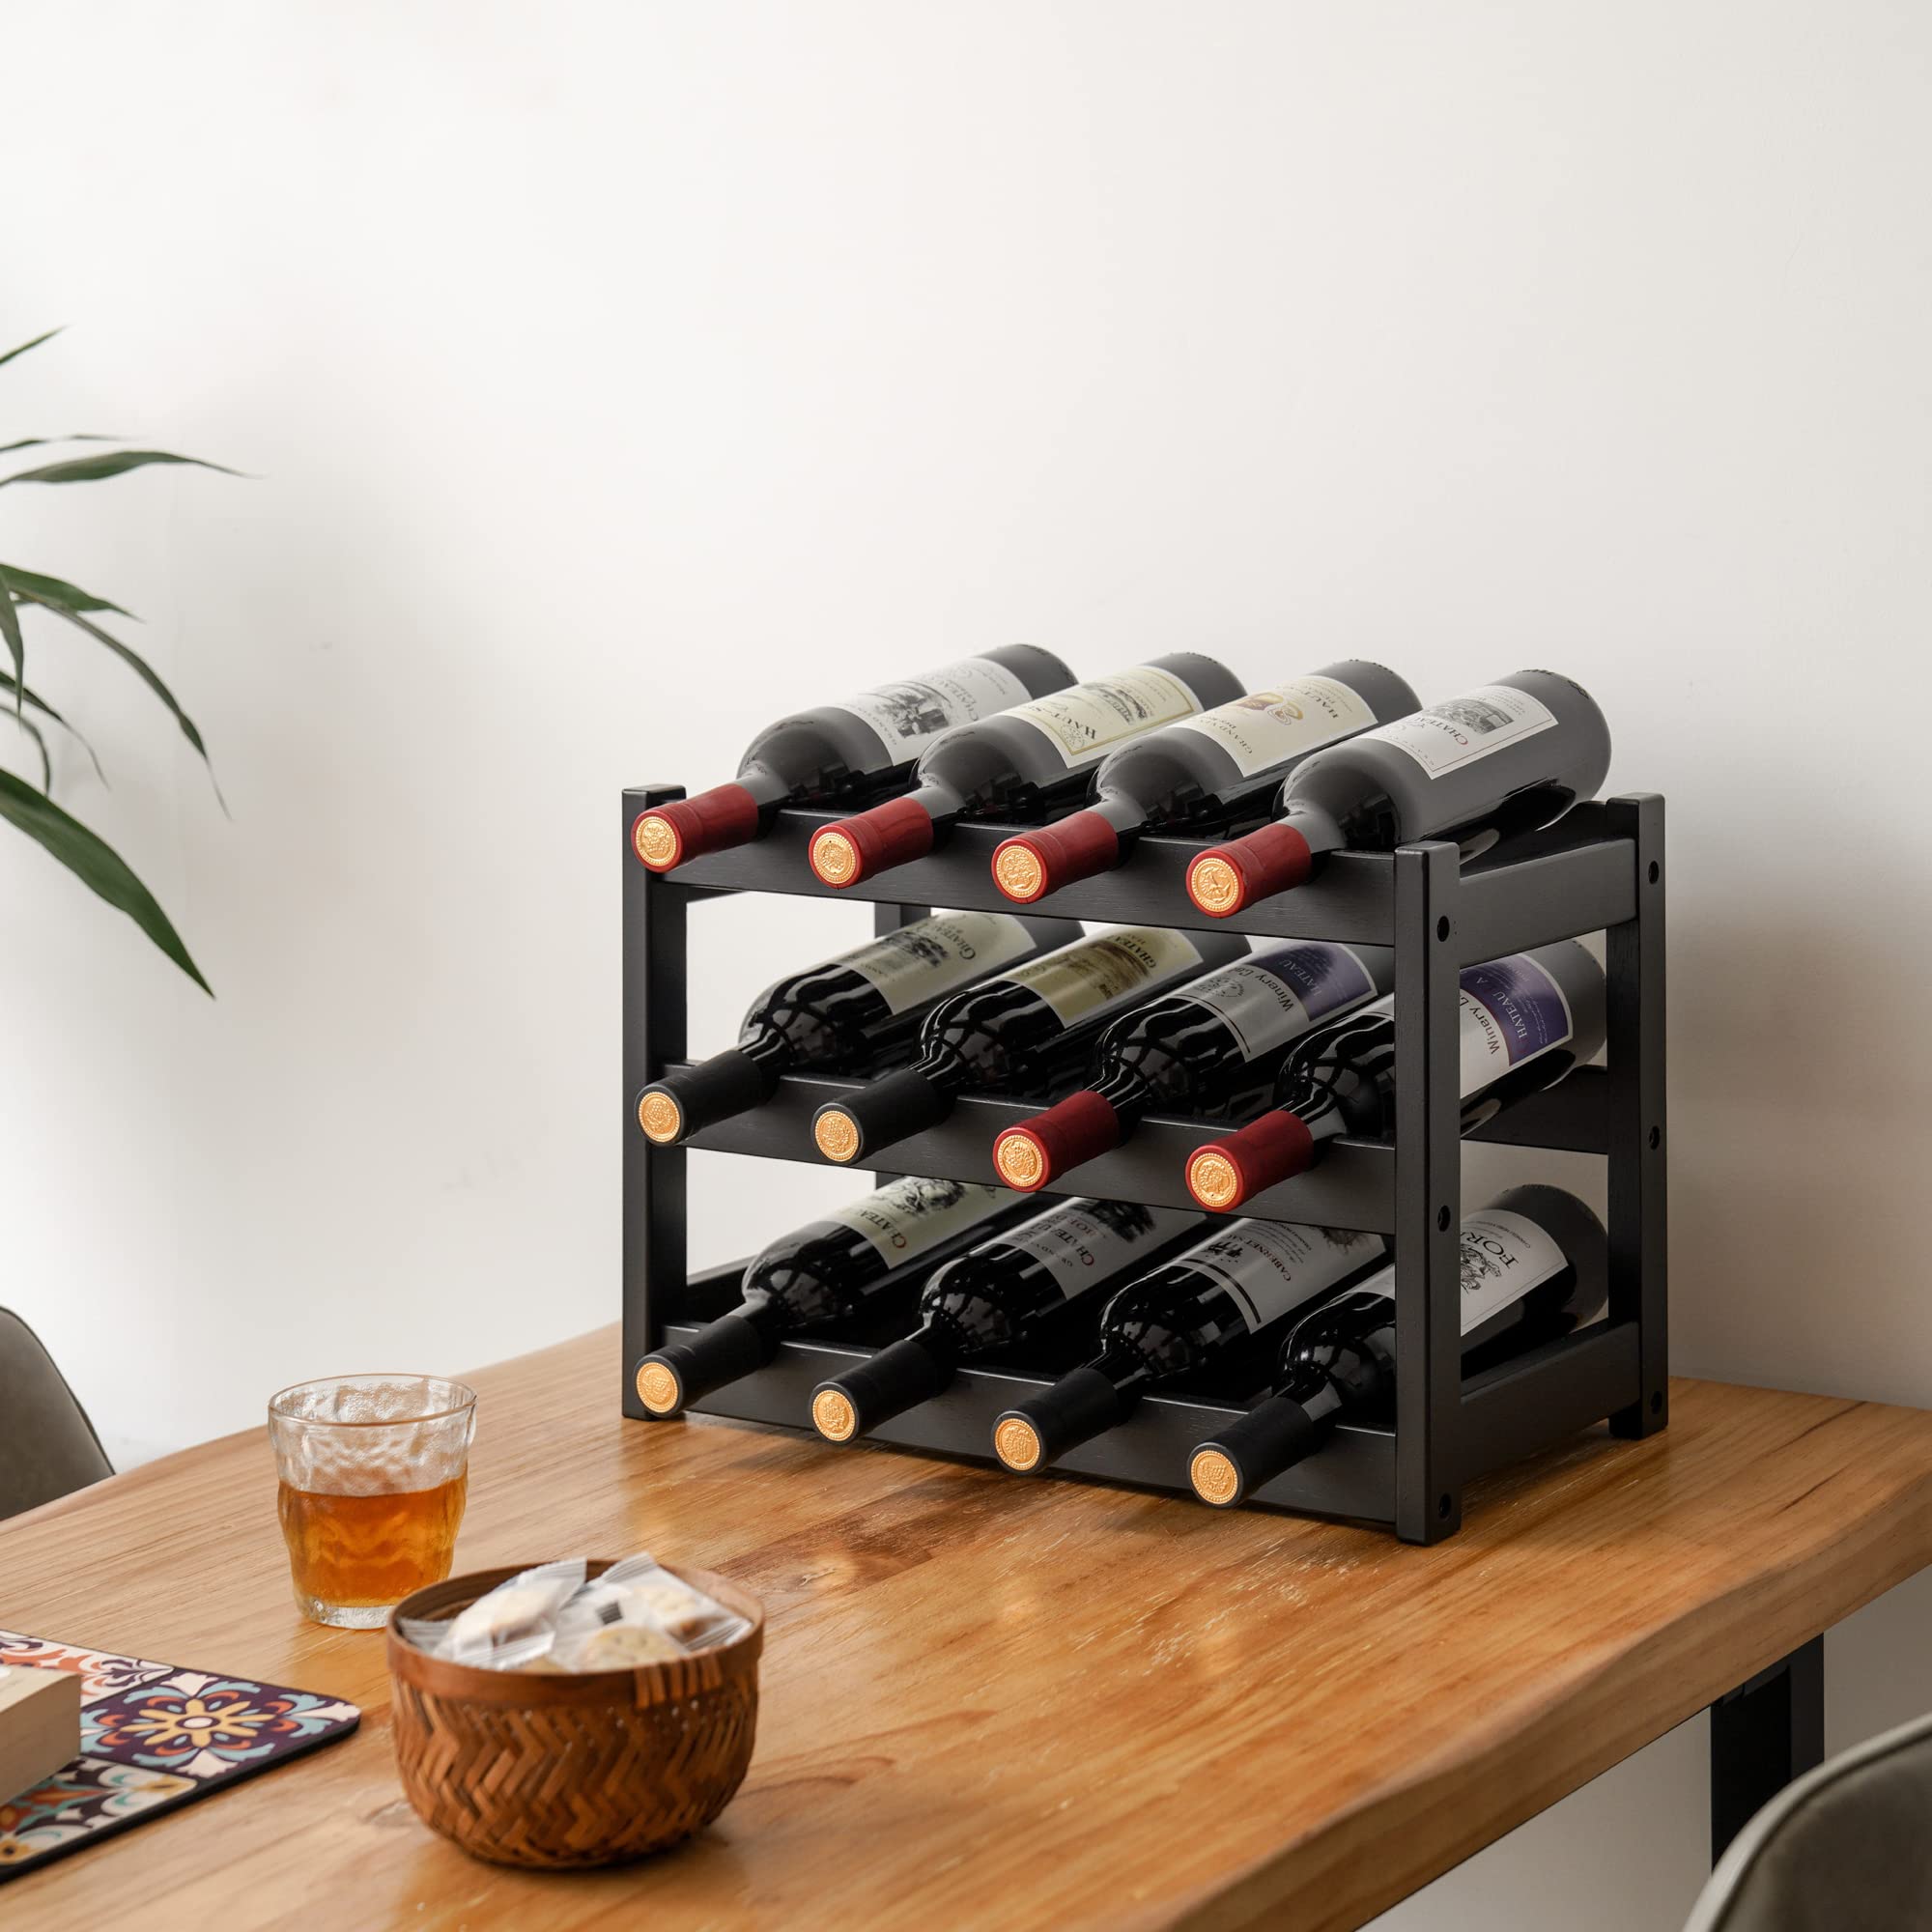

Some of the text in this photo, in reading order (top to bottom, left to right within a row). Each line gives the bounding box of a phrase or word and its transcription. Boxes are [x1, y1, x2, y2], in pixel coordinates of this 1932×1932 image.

[1255, 973, 1294, 1012] Winery
[1469, 1006, 1500, 1055] Winery
[1245, 1239, 1292, 1282] CABERNET
